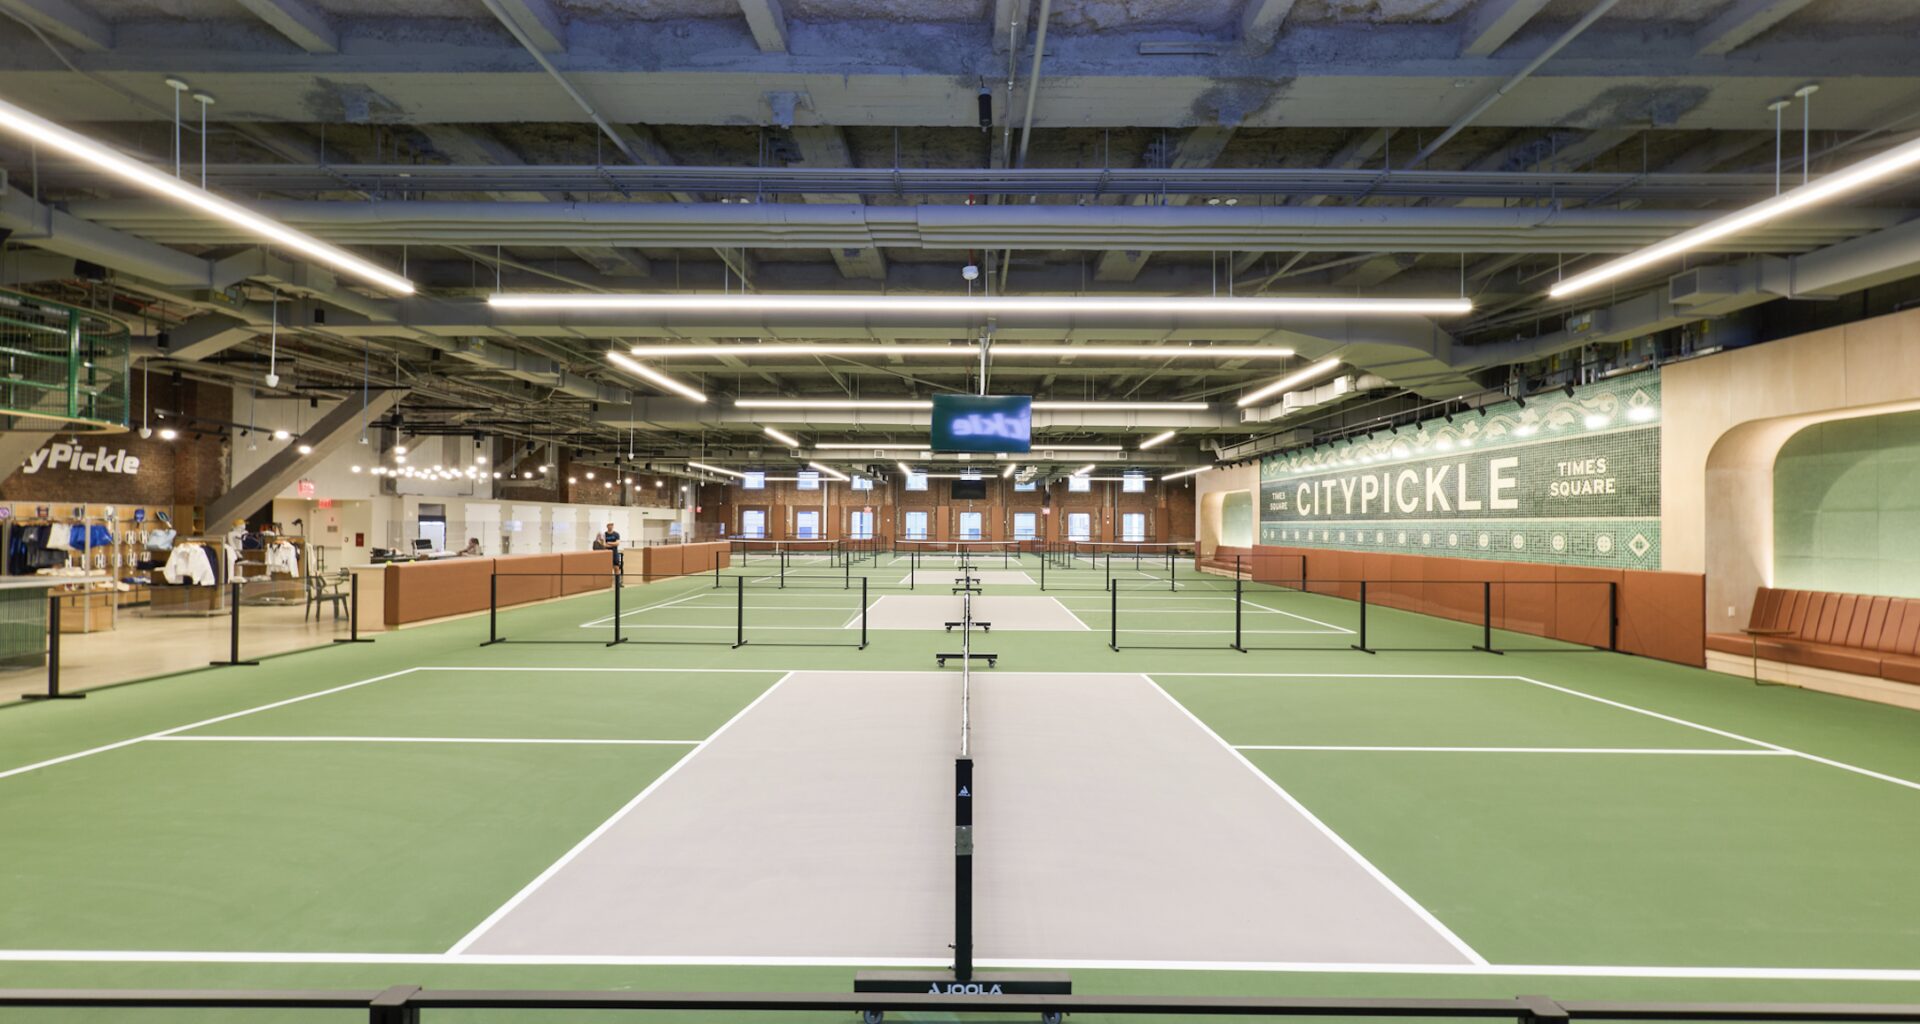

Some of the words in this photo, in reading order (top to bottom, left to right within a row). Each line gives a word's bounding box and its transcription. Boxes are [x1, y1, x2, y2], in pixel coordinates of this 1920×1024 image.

[22, 443, 140, 475] yPickle
[1557, 457, 1607, 476] TIMES
[1296, 456, 1519, 517] CITYPICKLE
[1550, 478, 1616, 497] SQUARE
[943, 984, 1003, 995] JOOLA
